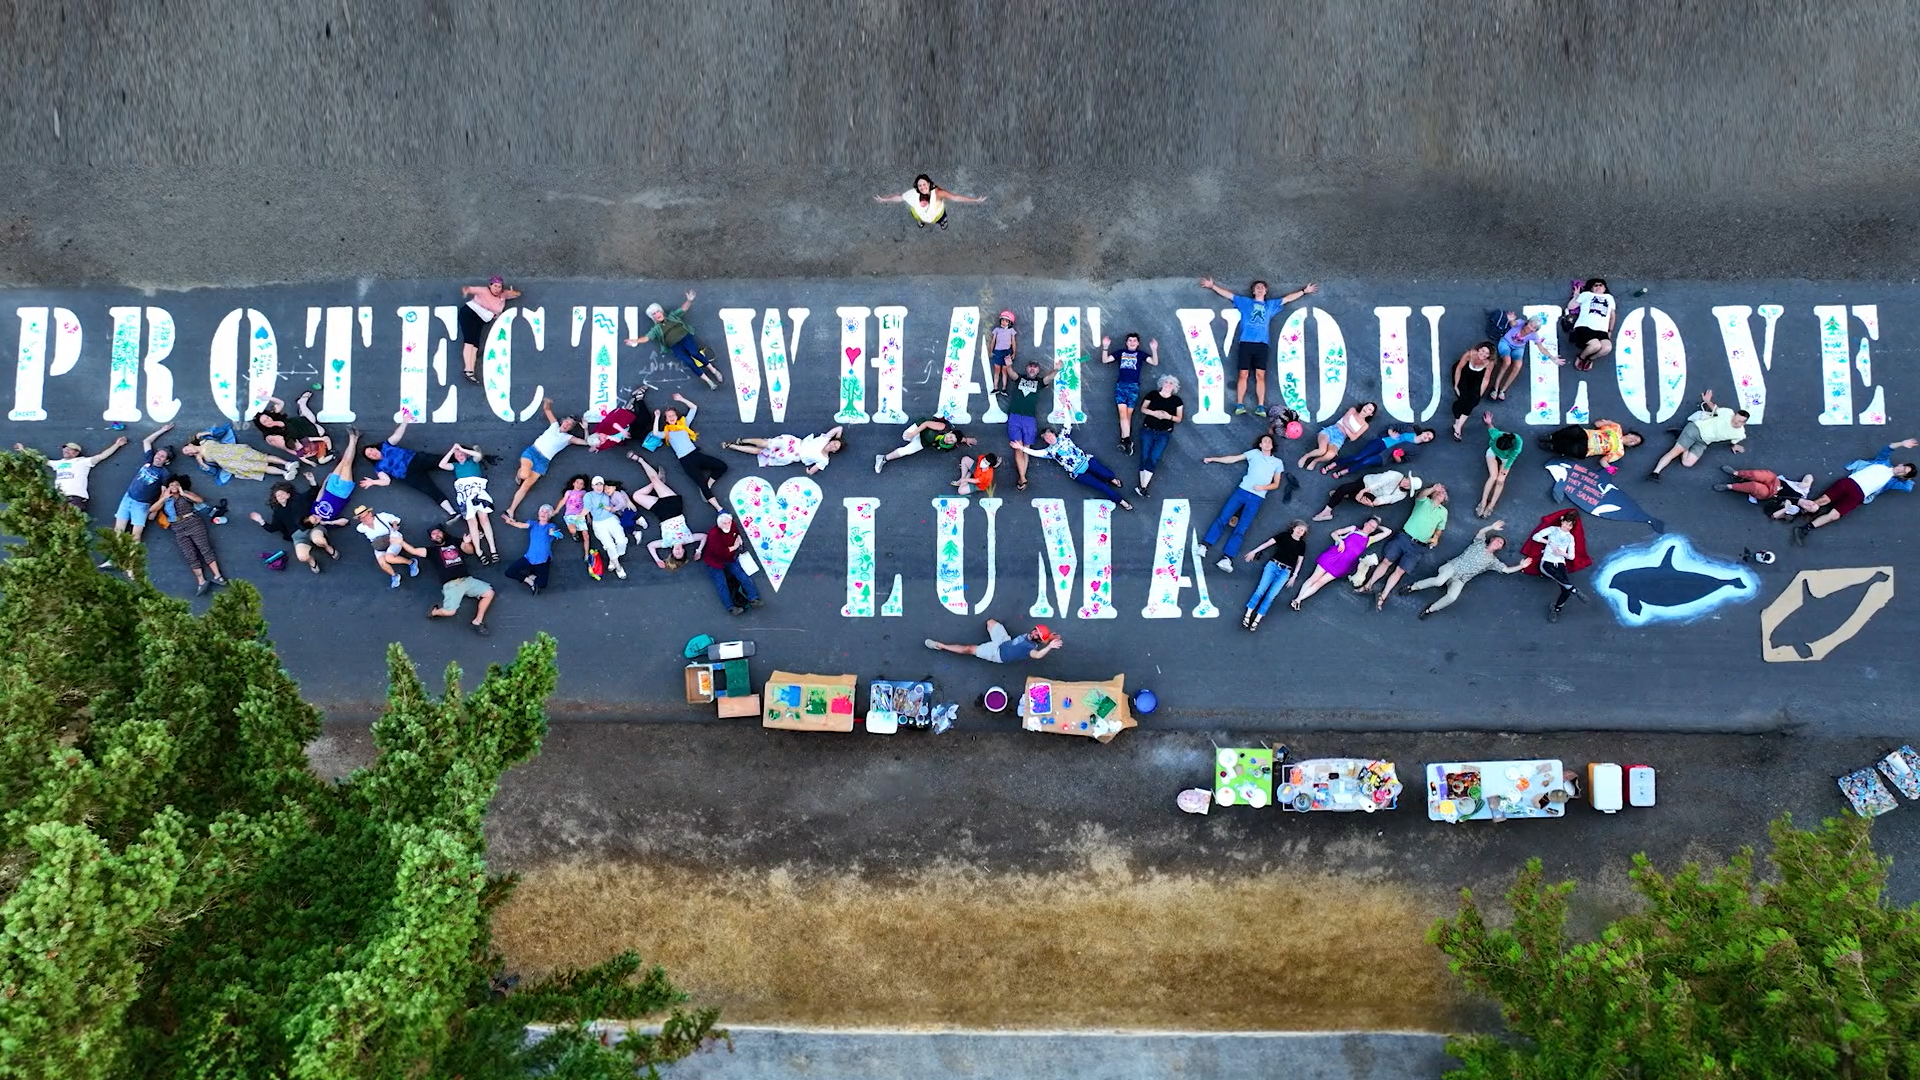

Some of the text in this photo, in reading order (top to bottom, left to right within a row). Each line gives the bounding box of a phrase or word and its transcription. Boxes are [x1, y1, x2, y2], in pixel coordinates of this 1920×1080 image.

[8, 304, 1886, 425] PROTECT WHAT YOU LOVE
[1565, 485, 1599, 506] MY SALMON
[1568, 477, 1581, 486] THEY
[841, 496, 1220, 619] LUMA
